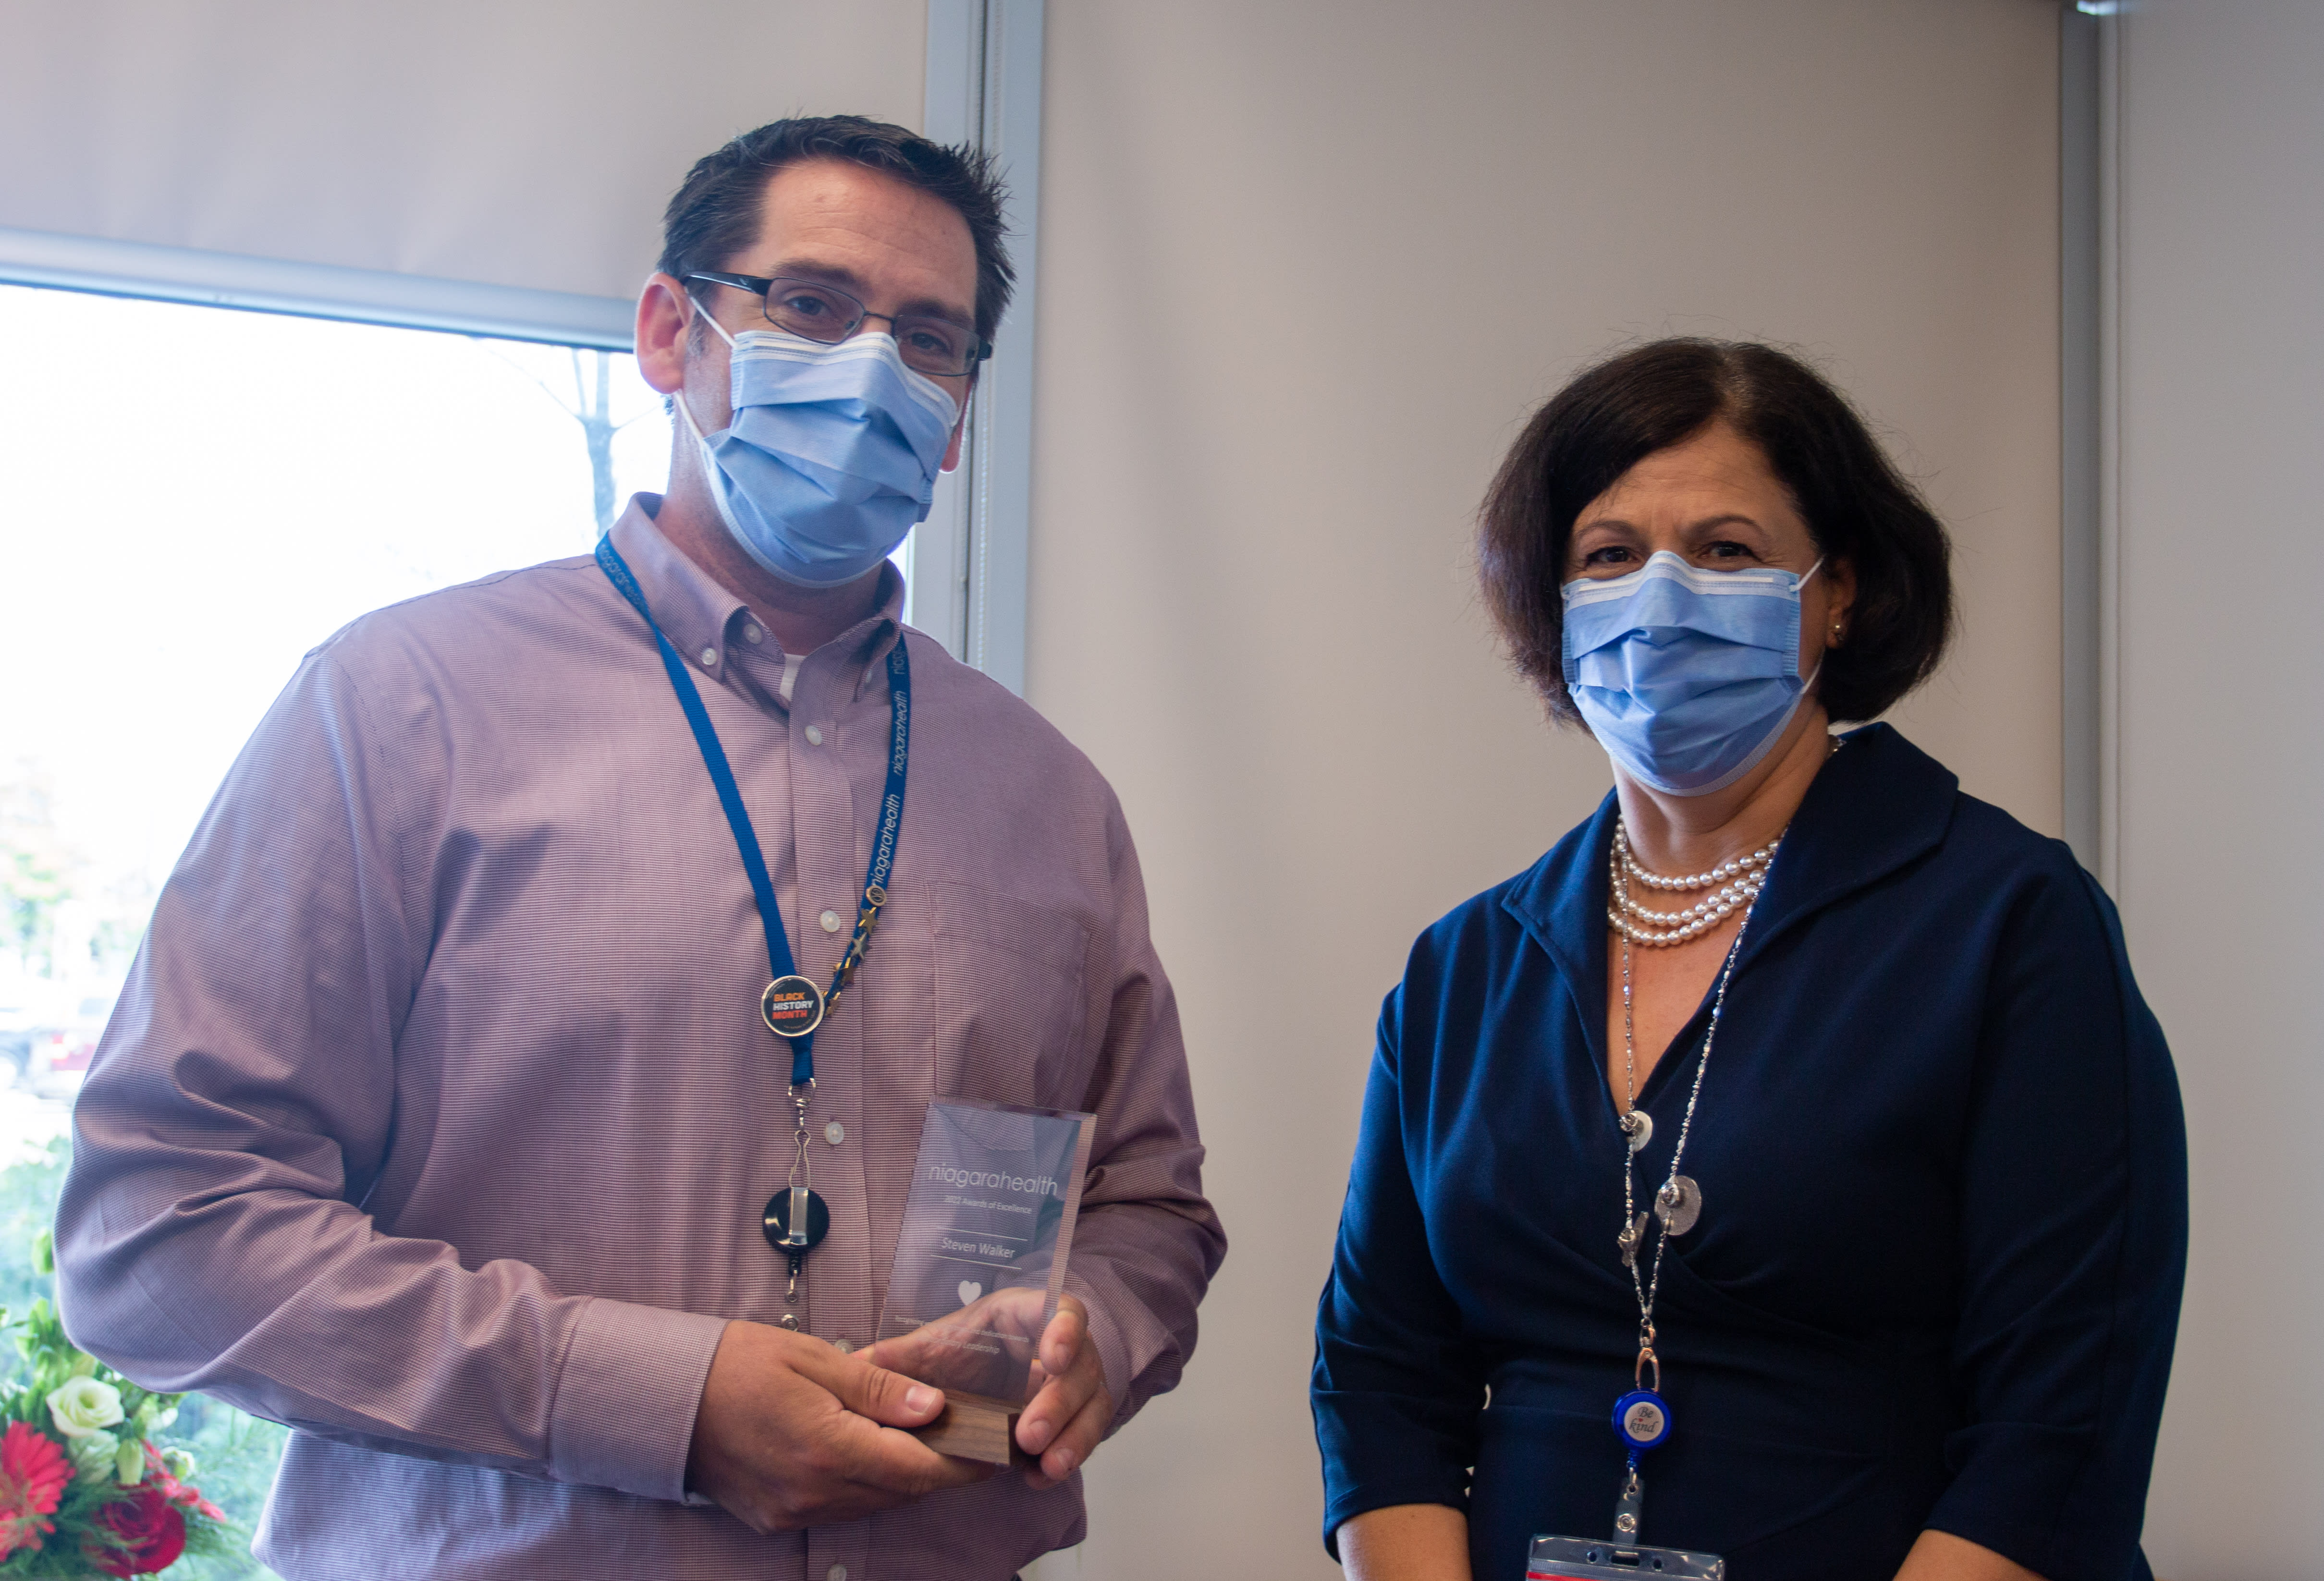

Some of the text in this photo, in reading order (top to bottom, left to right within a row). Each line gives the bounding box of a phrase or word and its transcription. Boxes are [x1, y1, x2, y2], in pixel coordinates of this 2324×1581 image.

[892, 690, 907, 776] niagarahealth
[869, 793, 901, 887] niagarahealth
[774, 992, 806, 1002] BLACK
[773, 1001, 814, 1010] HISTORY
[772, 1010, 807, 1019] MONTH
[929, 1162, 1058, 1195] niagarahealth
[963, 1198, 987, 1208] Awards
[988, 1201, 997, 1209] of
[997, 1202, 1032, 1214] Excellence
[942, 1237, 1015, 1258] Steven Walker
[963, 1343, 1000, 1354] Leadership
[1638, 1406, 1654, 1418] Be
[1629, 1418, 1659, 1434] kind
